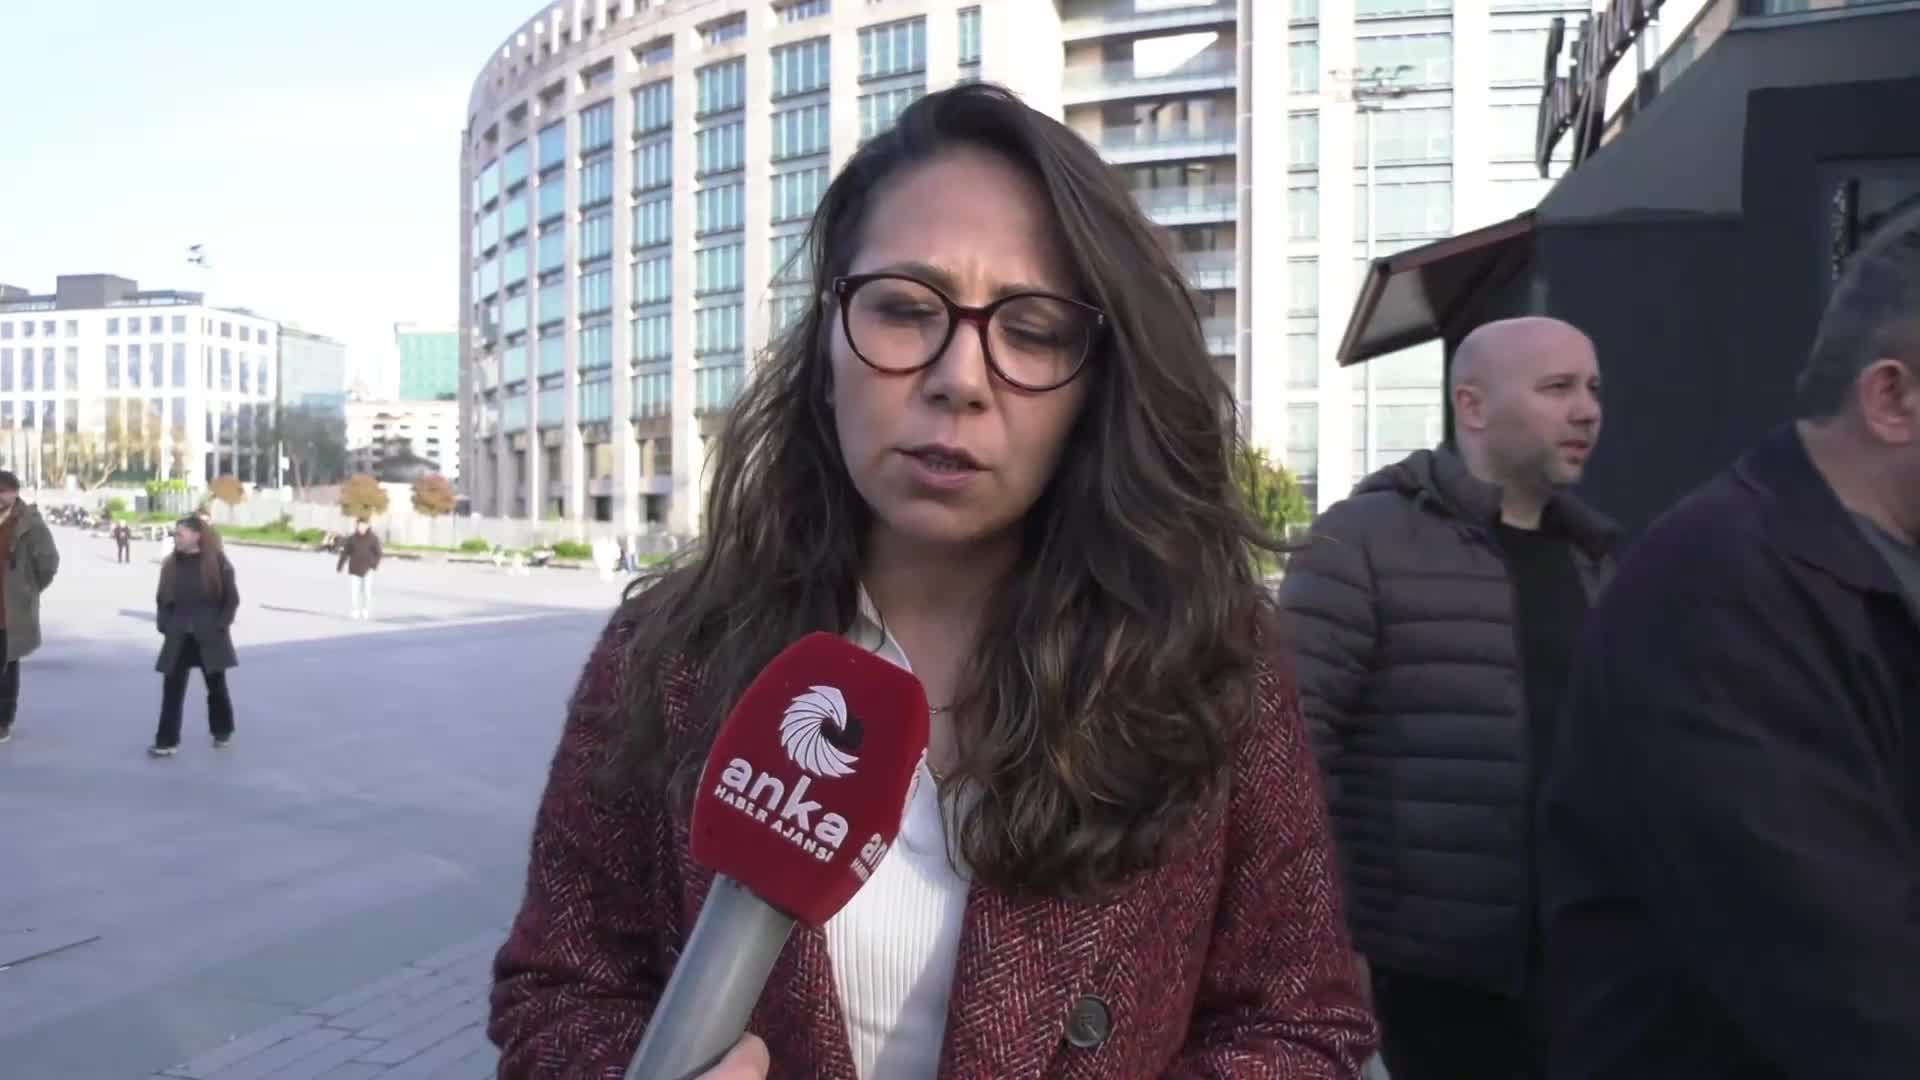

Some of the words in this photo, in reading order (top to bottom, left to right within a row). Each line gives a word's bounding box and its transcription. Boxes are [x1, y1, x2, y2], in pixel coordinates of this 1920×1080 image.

[713, 784, 768, 824] HABER
[770, 820, 835, 863] AJANSI
[721, 758, 849, 850] anka
